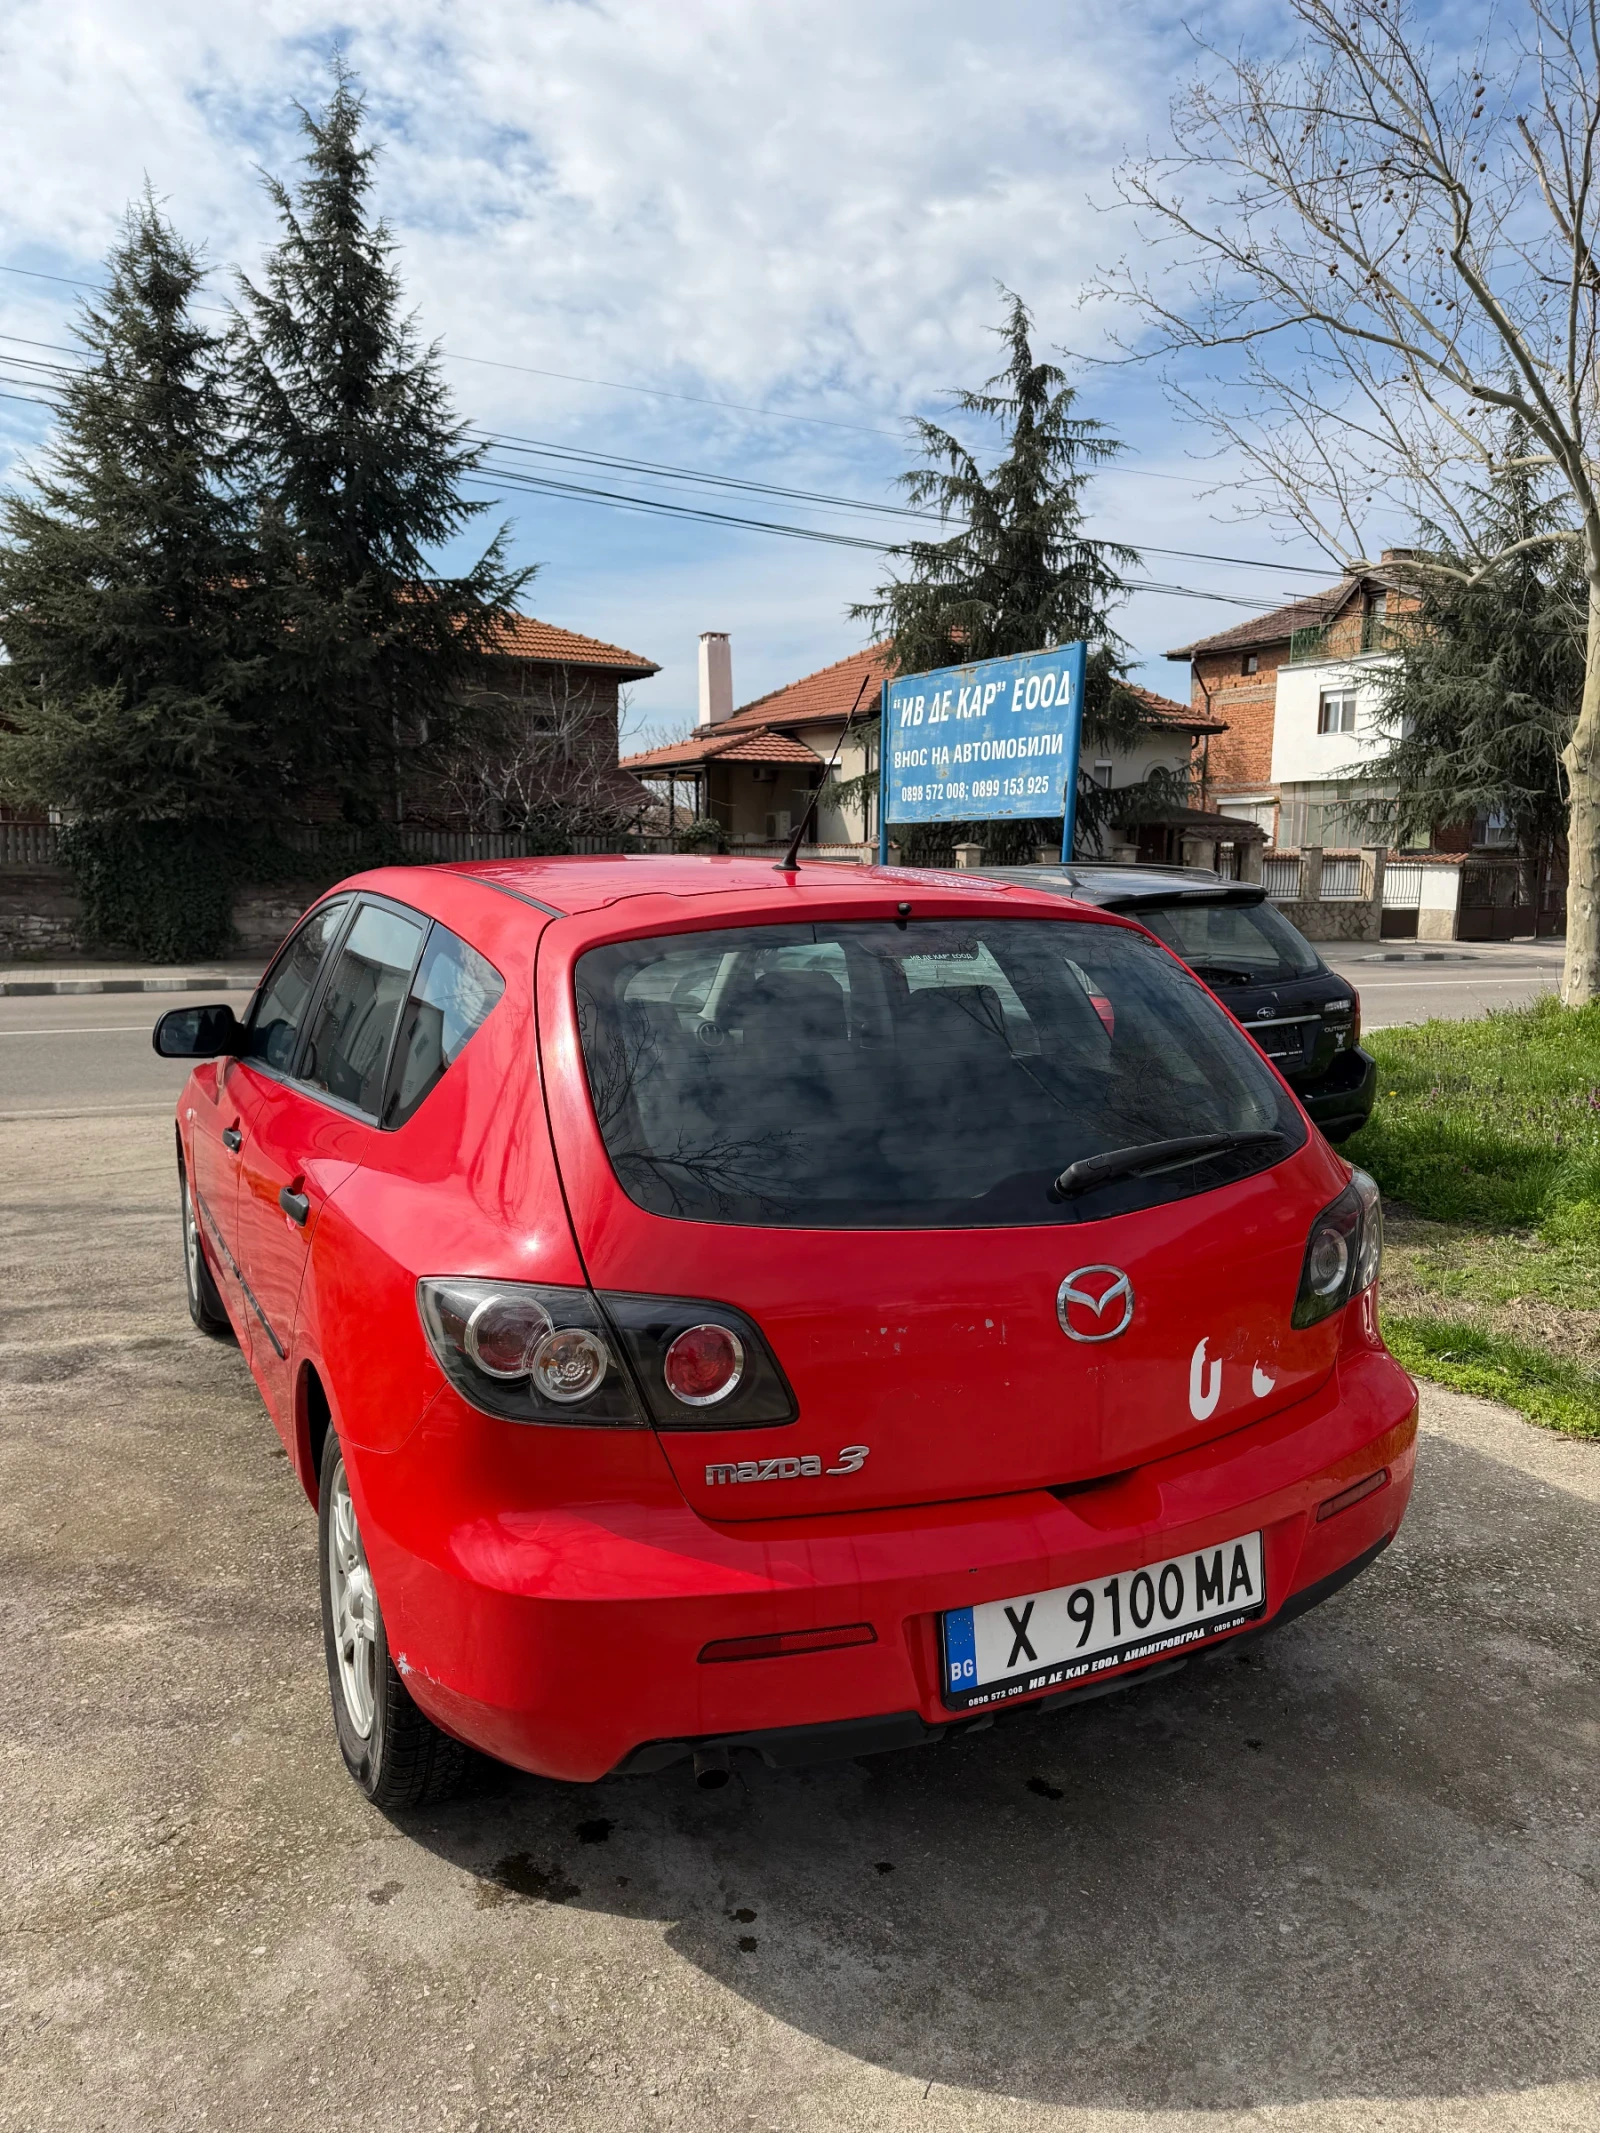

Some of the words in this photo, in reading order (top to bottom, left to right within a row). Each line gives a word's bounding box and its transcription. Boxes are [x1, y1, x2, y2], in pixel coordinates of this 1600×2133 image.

[928, 690, 952, 724] ДЕ
[1011, 671, 1070, 712] ЕООД
[894, 749, 927, 768] ВНОС
[932, 745, 949, 765] НА
[953, 734, 1063, 764] АВТОМОБИЛИ
[902, 786, 923, 801] 0898
[926, 784, 943, 800] 572
[946, 782, 969, 801] 008;
[972, 779, 999, 797] 0899
[1003, 777, 1024, 795] 153
[1027, 775, 1049, 794] 925
[1324, 1023, 1352, 1033] OUTBACK
[825, 1445, 870, 1475] 3
[1067, 1563, 1185, 1648] 9100
[1194, 1544, 1253, 1612] MA
[951, 1658, 974, 1681] BG
[968, 1696, 989, 1707] 0898
[991, 1690, 1006, 1700] 572
[1008, 1685, 1023, 1696] 008
[1029, 1676, 1046, 1690] ИВ
[1048, 1671, 1062, 1684] ДЕ
[1065, 1665, 1089, 1680] КАР
[1091, 1656, 1119, 1673] ЕООД
[1124, 1627, 1205, 1662] ДИМИТРОВГРАД
